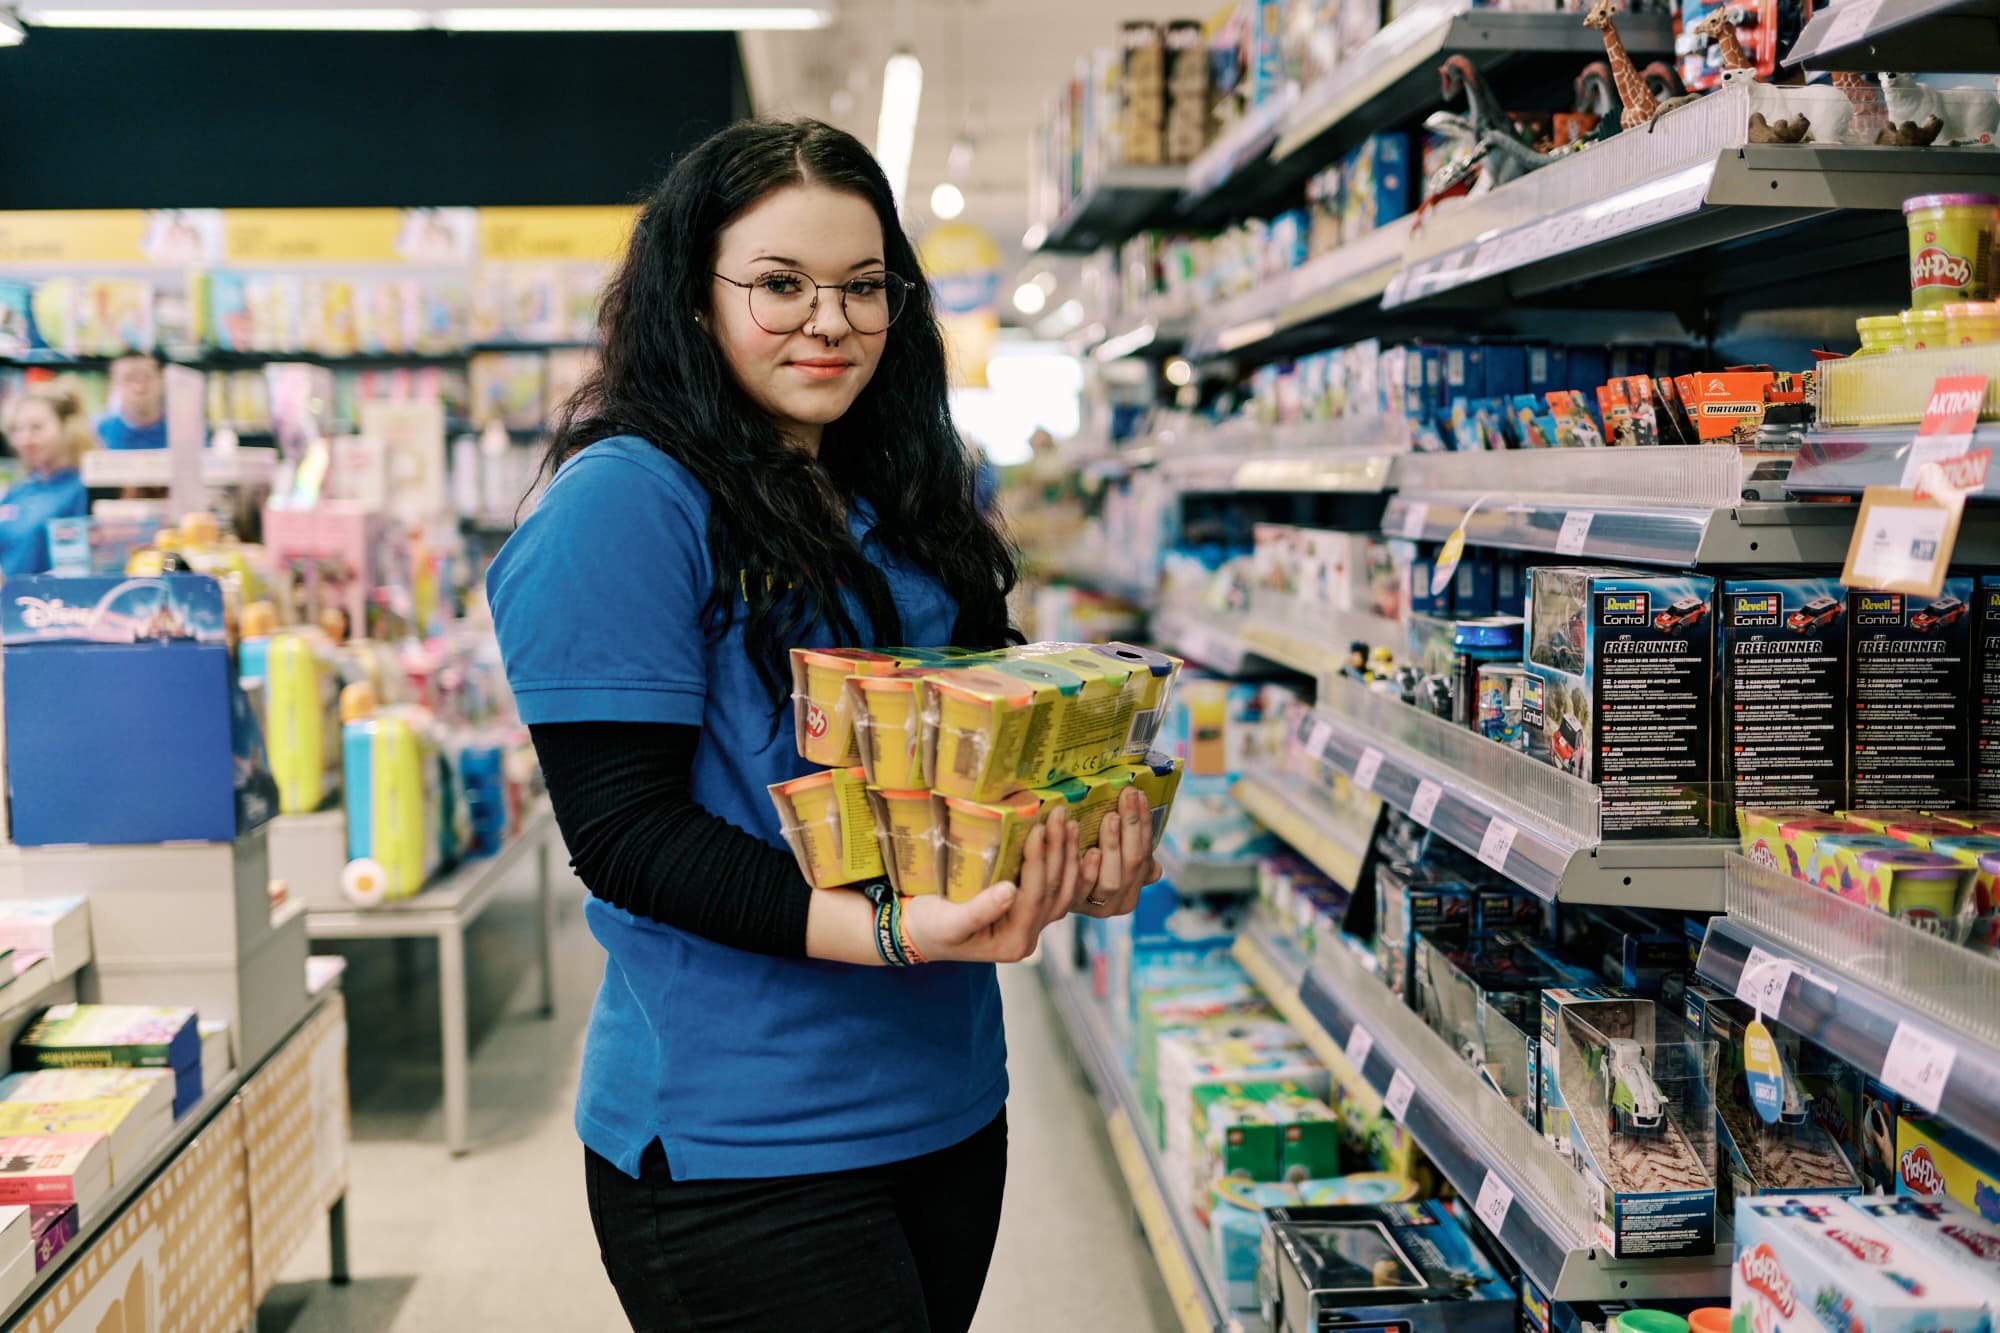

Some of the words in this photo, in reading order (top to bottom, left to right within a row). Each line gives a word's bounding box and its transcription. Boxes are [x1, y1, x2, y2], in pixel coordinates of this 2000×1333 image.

[1706, 404, 1759, 413] MATCHBOX
[1927, 390, 1983, 415] AKTION
[1605, 597, 1636, 610] Revell
[1738, 598, 1768, 611] Revell
[1861, 598, 1891, 610] Revell
[1603, 615, 1645, 624] Control
[1734, 616, 1777, 626] Control
[1857, 615, 1901, 624] Control
[1603, 641, 1635, 654] FREE
[1635, 641, 1688, 653] RUNNER
[1735, 641, 1768, 655] FREE
[1767, 641, 1823, 654] RUNNER
[1857, 641, 1890, 653] FREE
[1890, 640, 1946, 653] RUNNER
[1523, 707, 1542, 727] Control
